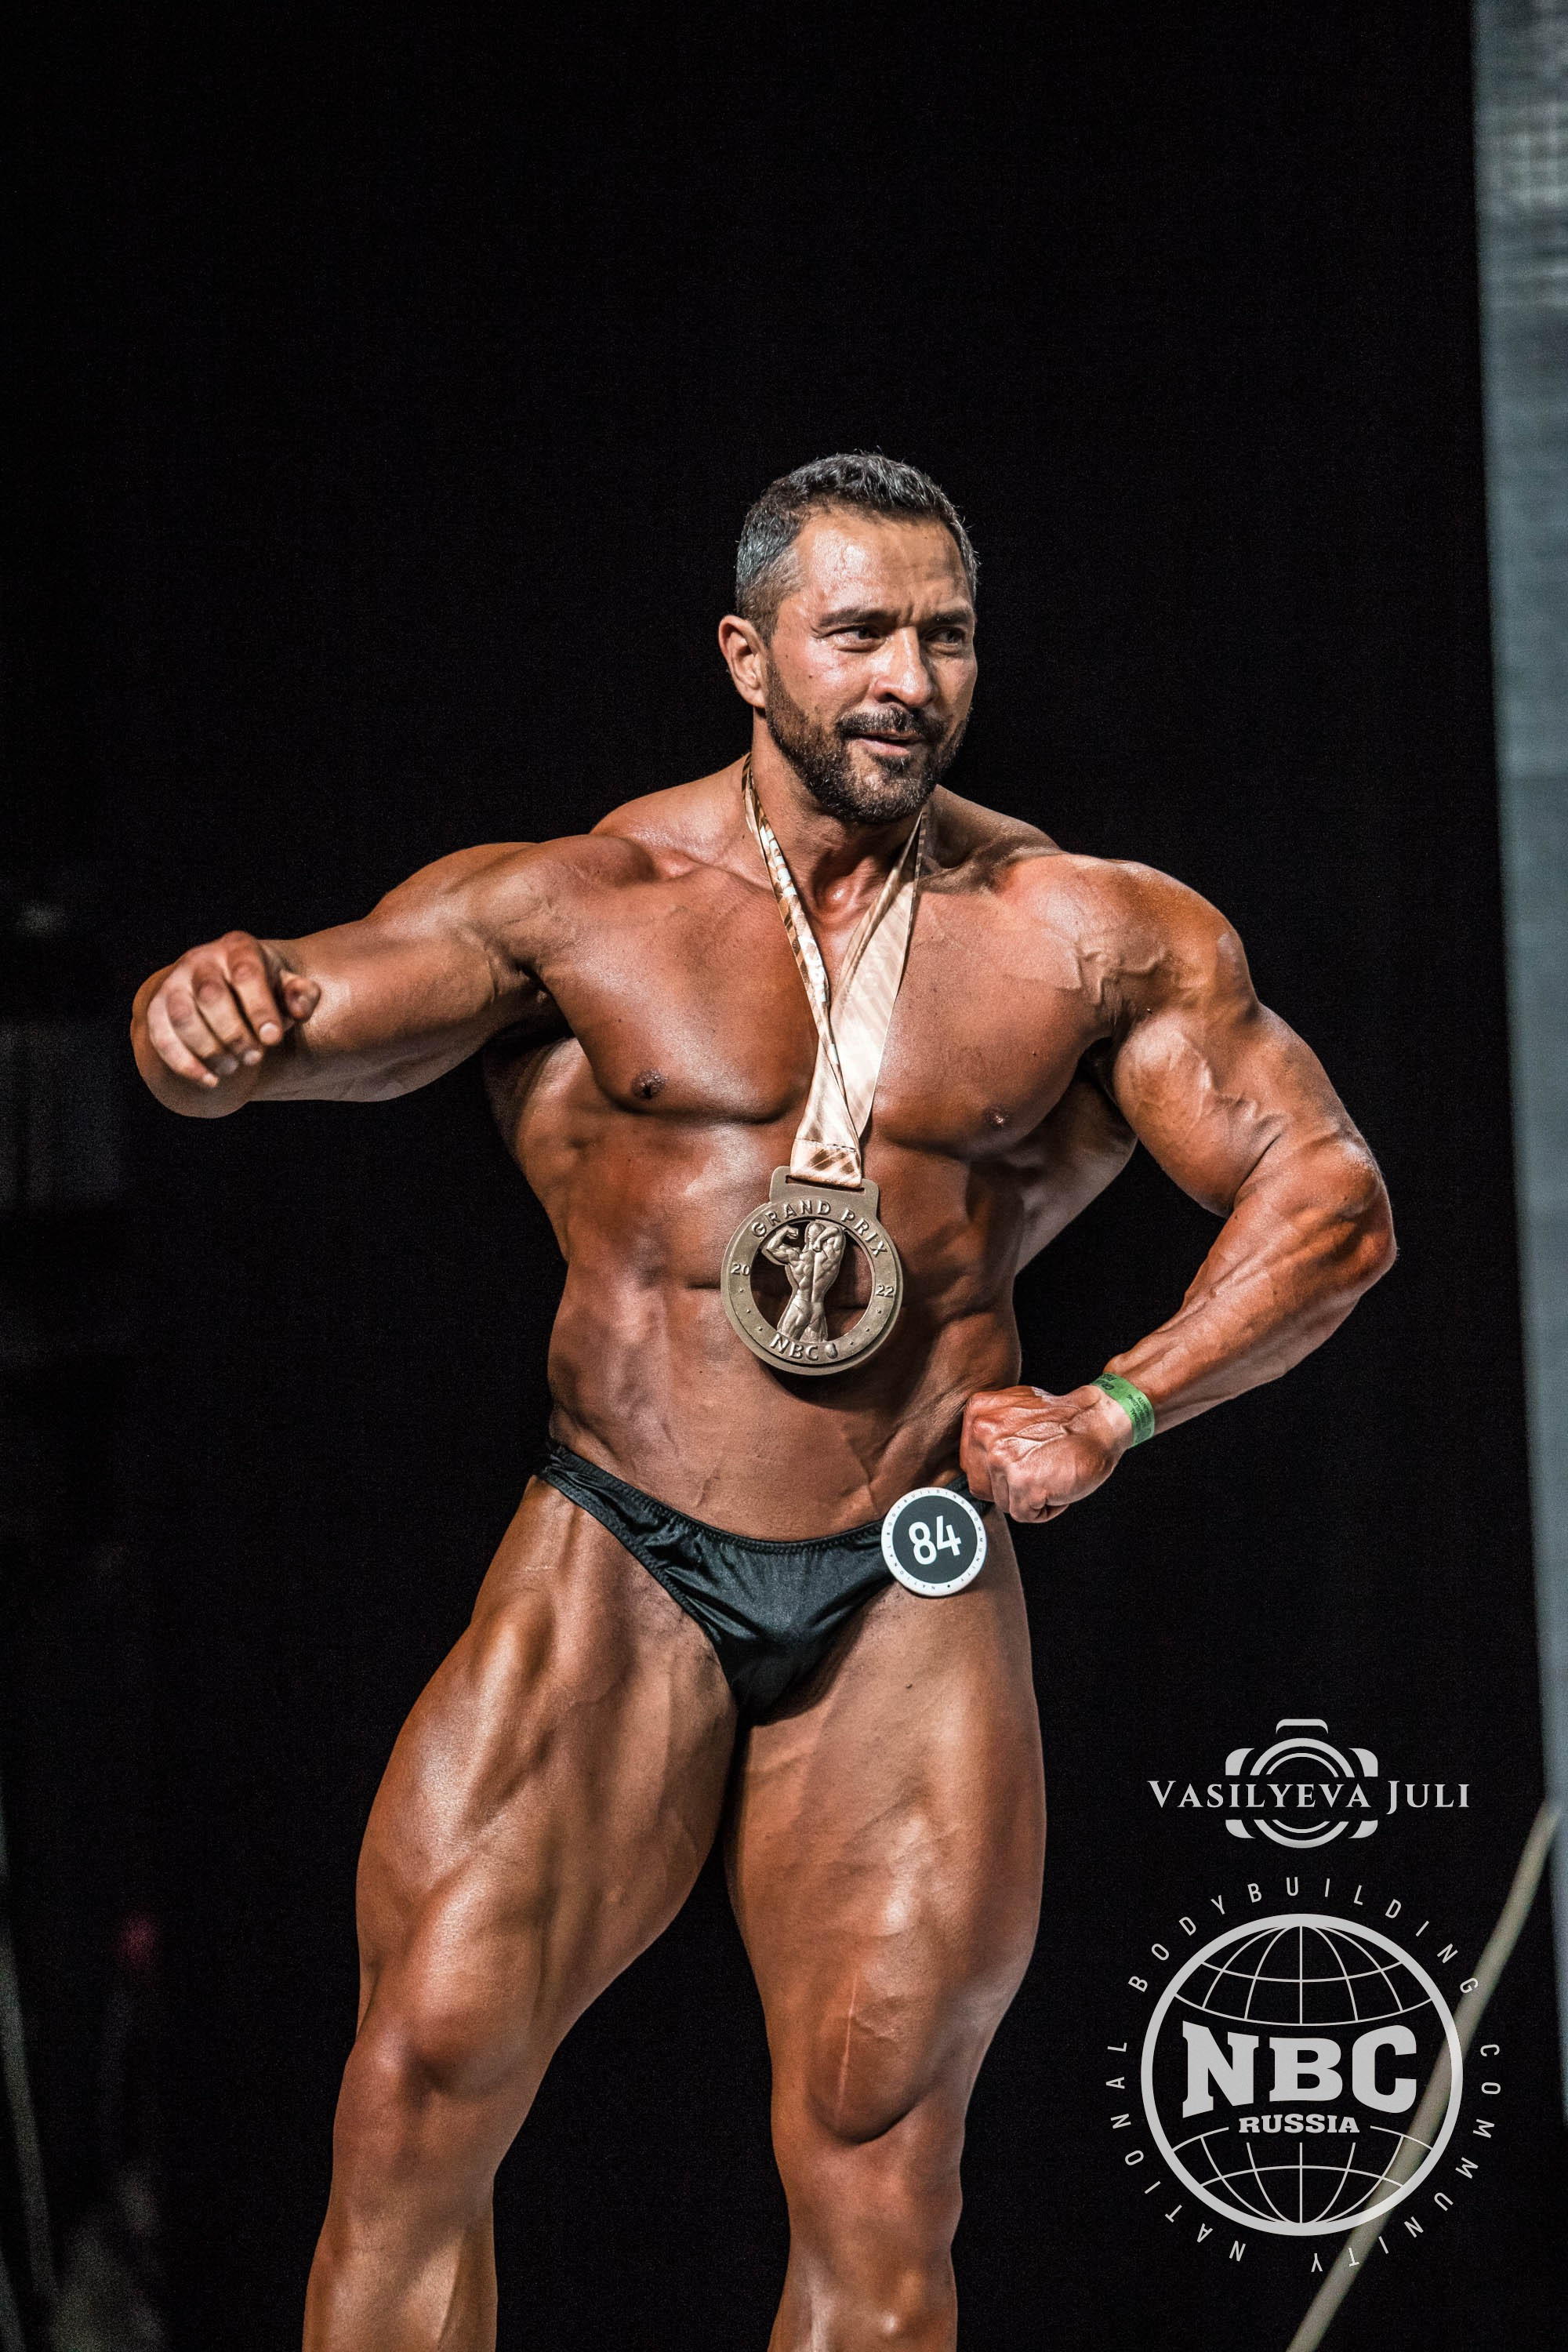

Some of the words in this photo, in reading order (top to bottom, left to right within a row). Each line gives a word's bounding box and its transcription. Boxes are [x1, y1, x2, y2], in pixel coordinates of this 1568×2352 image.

[750, 1199, 831, 1238] GRAND
[840, 1208, 888, 1258] PRIX
[731, 1262, 751, 1276] 20
[875, 1284, 895, 1298] 22
[770, 1332, 820, 1362] NBC
[908, 1515, 962, 1565] 84
